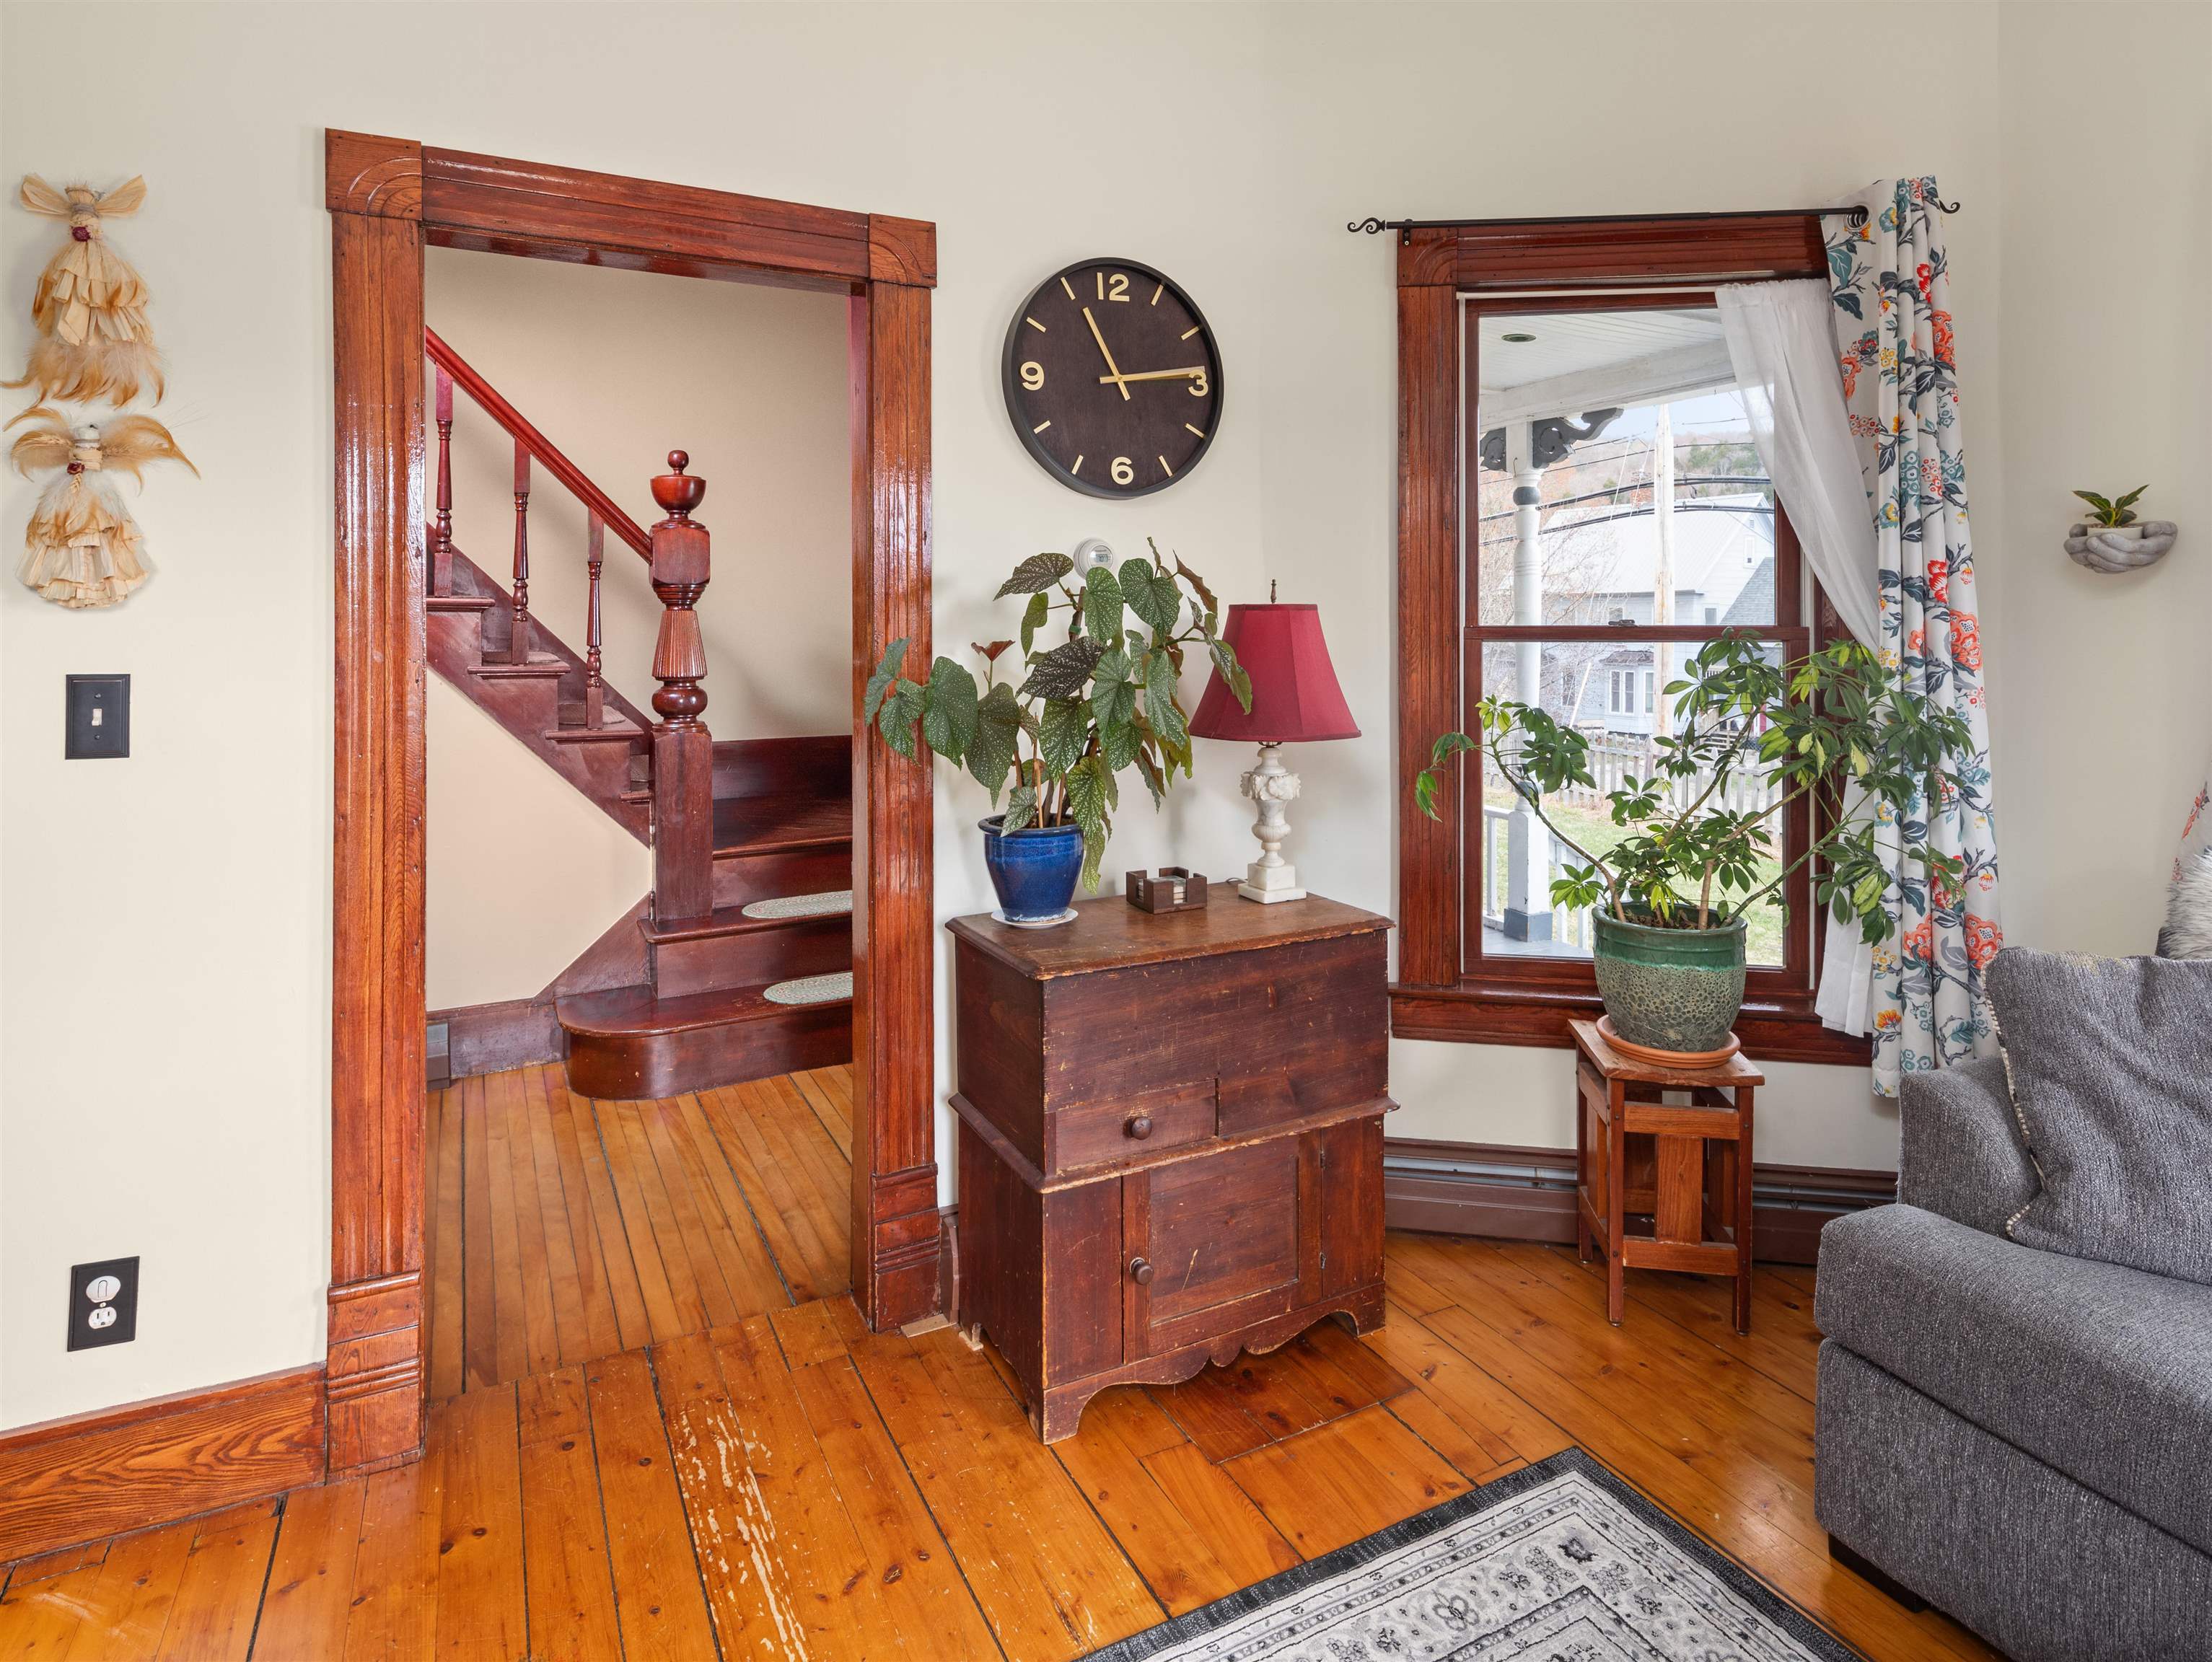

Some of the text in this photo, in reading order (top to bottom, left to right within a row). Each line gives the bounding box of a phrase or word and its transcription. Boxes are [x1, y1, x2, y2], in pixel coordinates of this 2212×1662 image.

[1097, 272, 1130, 302] 12
[1020, 361, 1045, 390] 9
[1188, 369, 1208, 397] 3
[1110, 457, 1133, 485] 6
